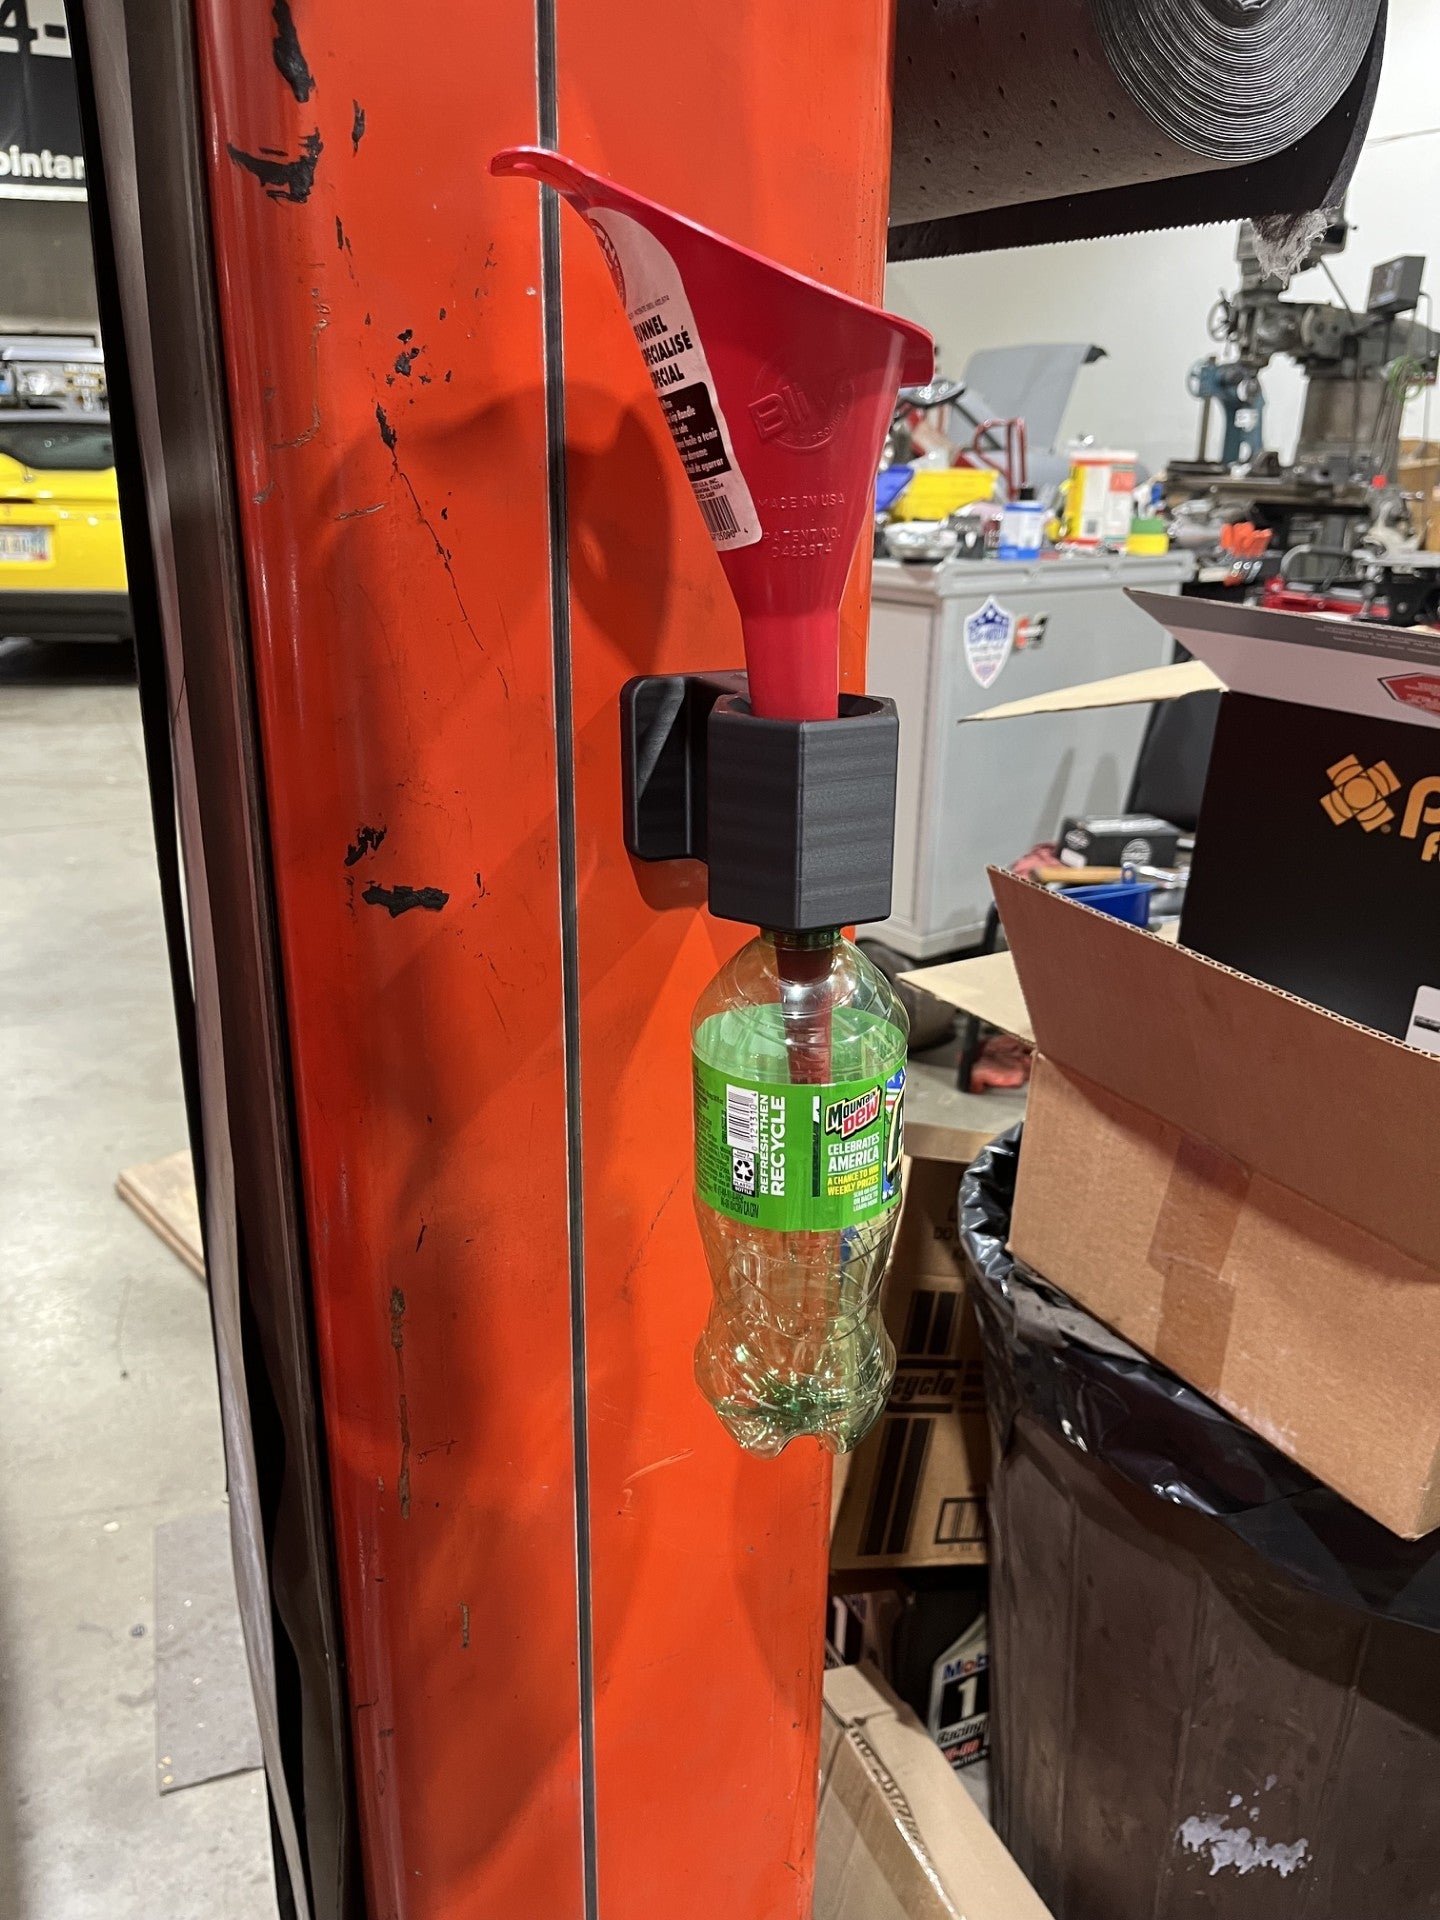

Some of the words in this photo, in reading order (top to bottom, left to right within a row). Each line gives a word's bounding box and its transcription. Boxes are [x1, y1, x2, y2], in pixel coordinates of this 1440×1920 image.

[758, 496, 798, 509] MADE
[802, 495, 817, 508] IN
[821, 493, 846, 506] USA
[763, 528, 817, 542] PATENT
[759, 1094, 769, 1133] THEN
[770, 1096, 786, 1196] RECYCLE
[828, 1132, 880, 1156] CELEBRATES
[759, 1134, 769, 1194] REFRESH
[828, 1146, 880, 1173] AMERICA
[827, 1175, 833, 1186] A
[833, 1170, 859, 1186] CHANCE
[859, 1168, 868, 1180] TO
[827, 1180, 856, 1197] WEEKLY
[856, 1174, 879, 1190] PRIZES
[734, 1186, 753, 1196] BOTTLE
[942, 1652, 988, 1680] Mob
[957, 1675, 978, 1721] 1
